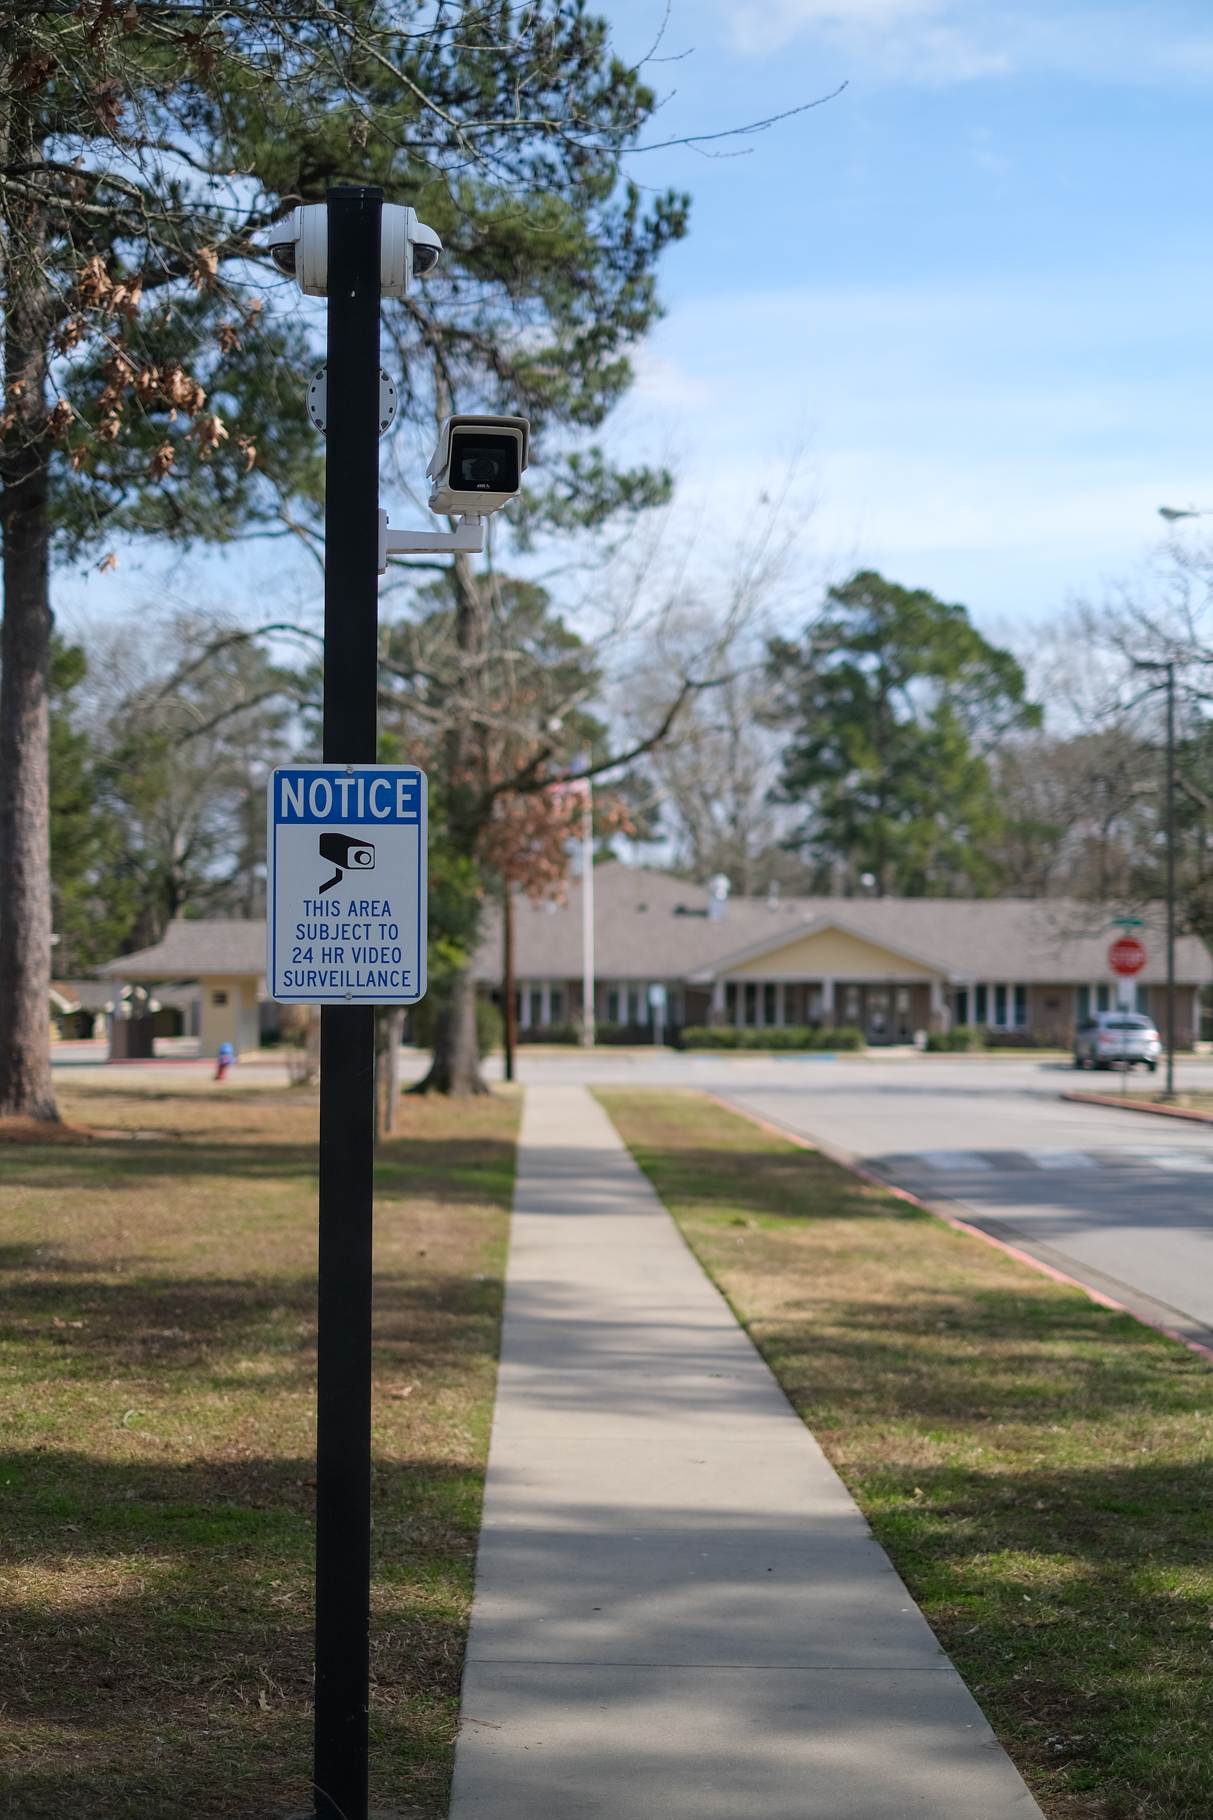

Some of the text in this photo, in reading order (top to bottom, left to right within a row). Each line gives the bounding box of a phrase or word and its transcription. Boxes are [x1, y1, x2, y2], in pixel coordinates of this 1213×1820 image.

[281, 777, 417, 818] NOTICE
[303, 900, 392, 917] THIS AREA
[295, 923, 399, 941] SUBJECT TO
[292, 946, 402, 964] 24 HR VIDEO
[283, 970, 411, 988] SURVEILLANCE
